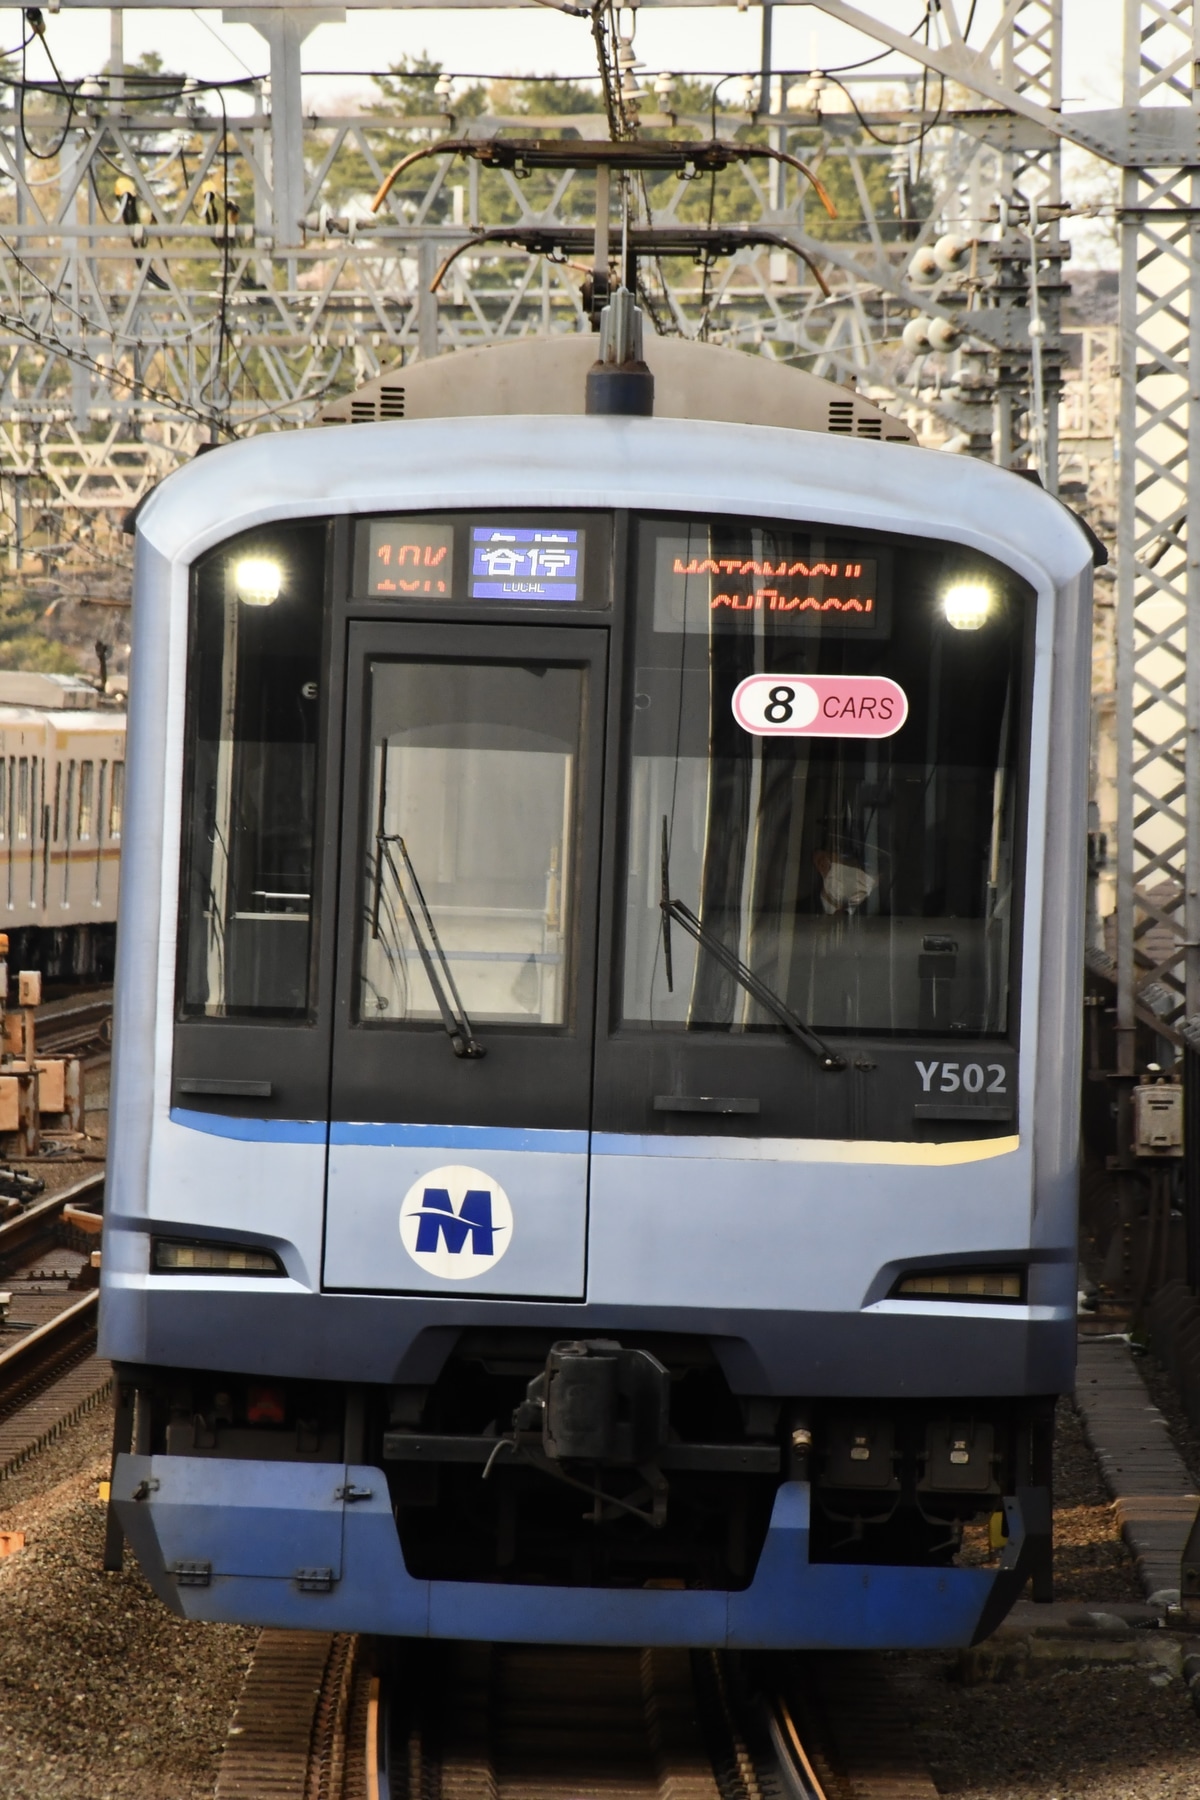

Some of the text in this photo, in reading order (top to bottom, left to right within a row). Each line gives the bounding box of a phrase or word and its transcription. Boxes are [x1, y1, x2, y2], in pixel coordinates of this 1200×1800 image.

[481, 532, 570, 577] 各停
[764, 686, 894, 723] 8 CARS
[914, 1061, 1007, 1093] Y502
[405, 1188, 507, 1256] M
